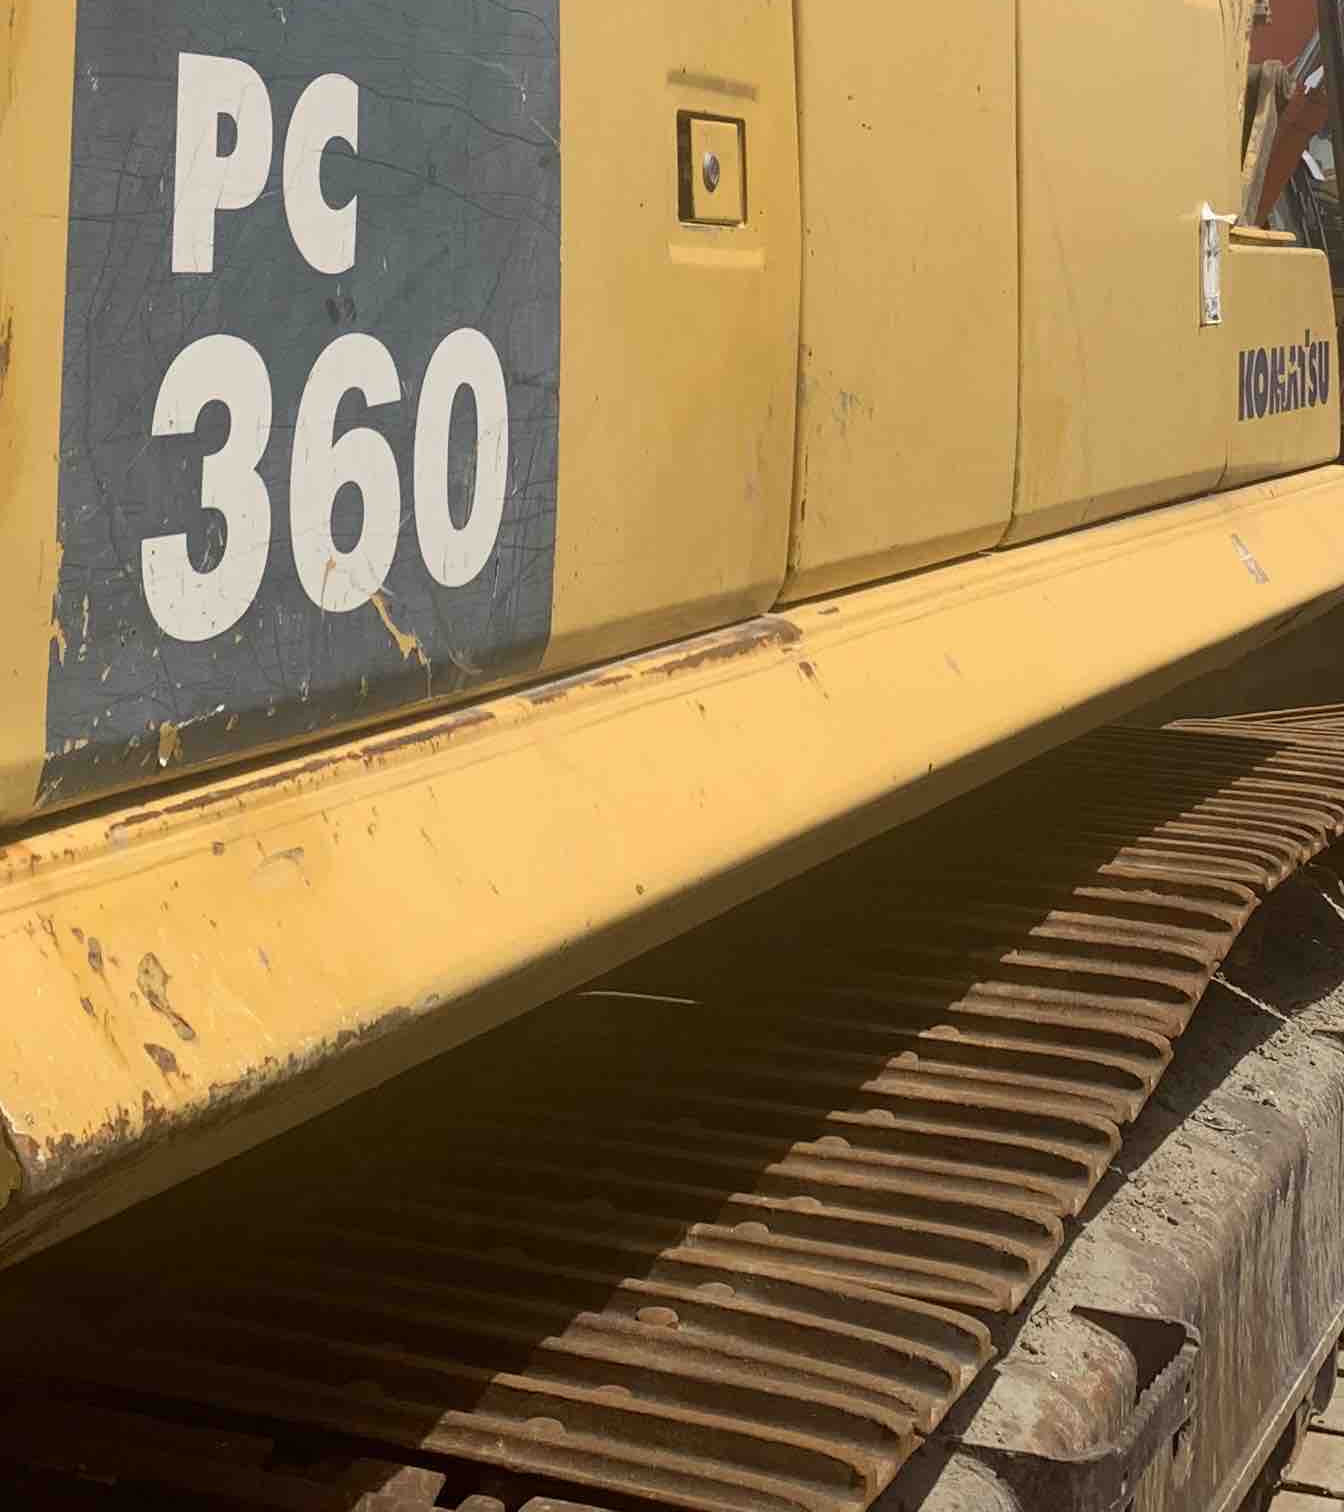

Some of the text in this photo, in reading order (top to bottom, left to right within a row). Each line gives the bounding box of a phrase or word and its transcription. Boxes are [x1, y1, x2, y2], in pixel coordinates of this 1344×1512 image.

[171, 52, 359, 275] PC
[141, 327, 509, 642] 360
[1238, 328, 1330, 421] KOMATSU
